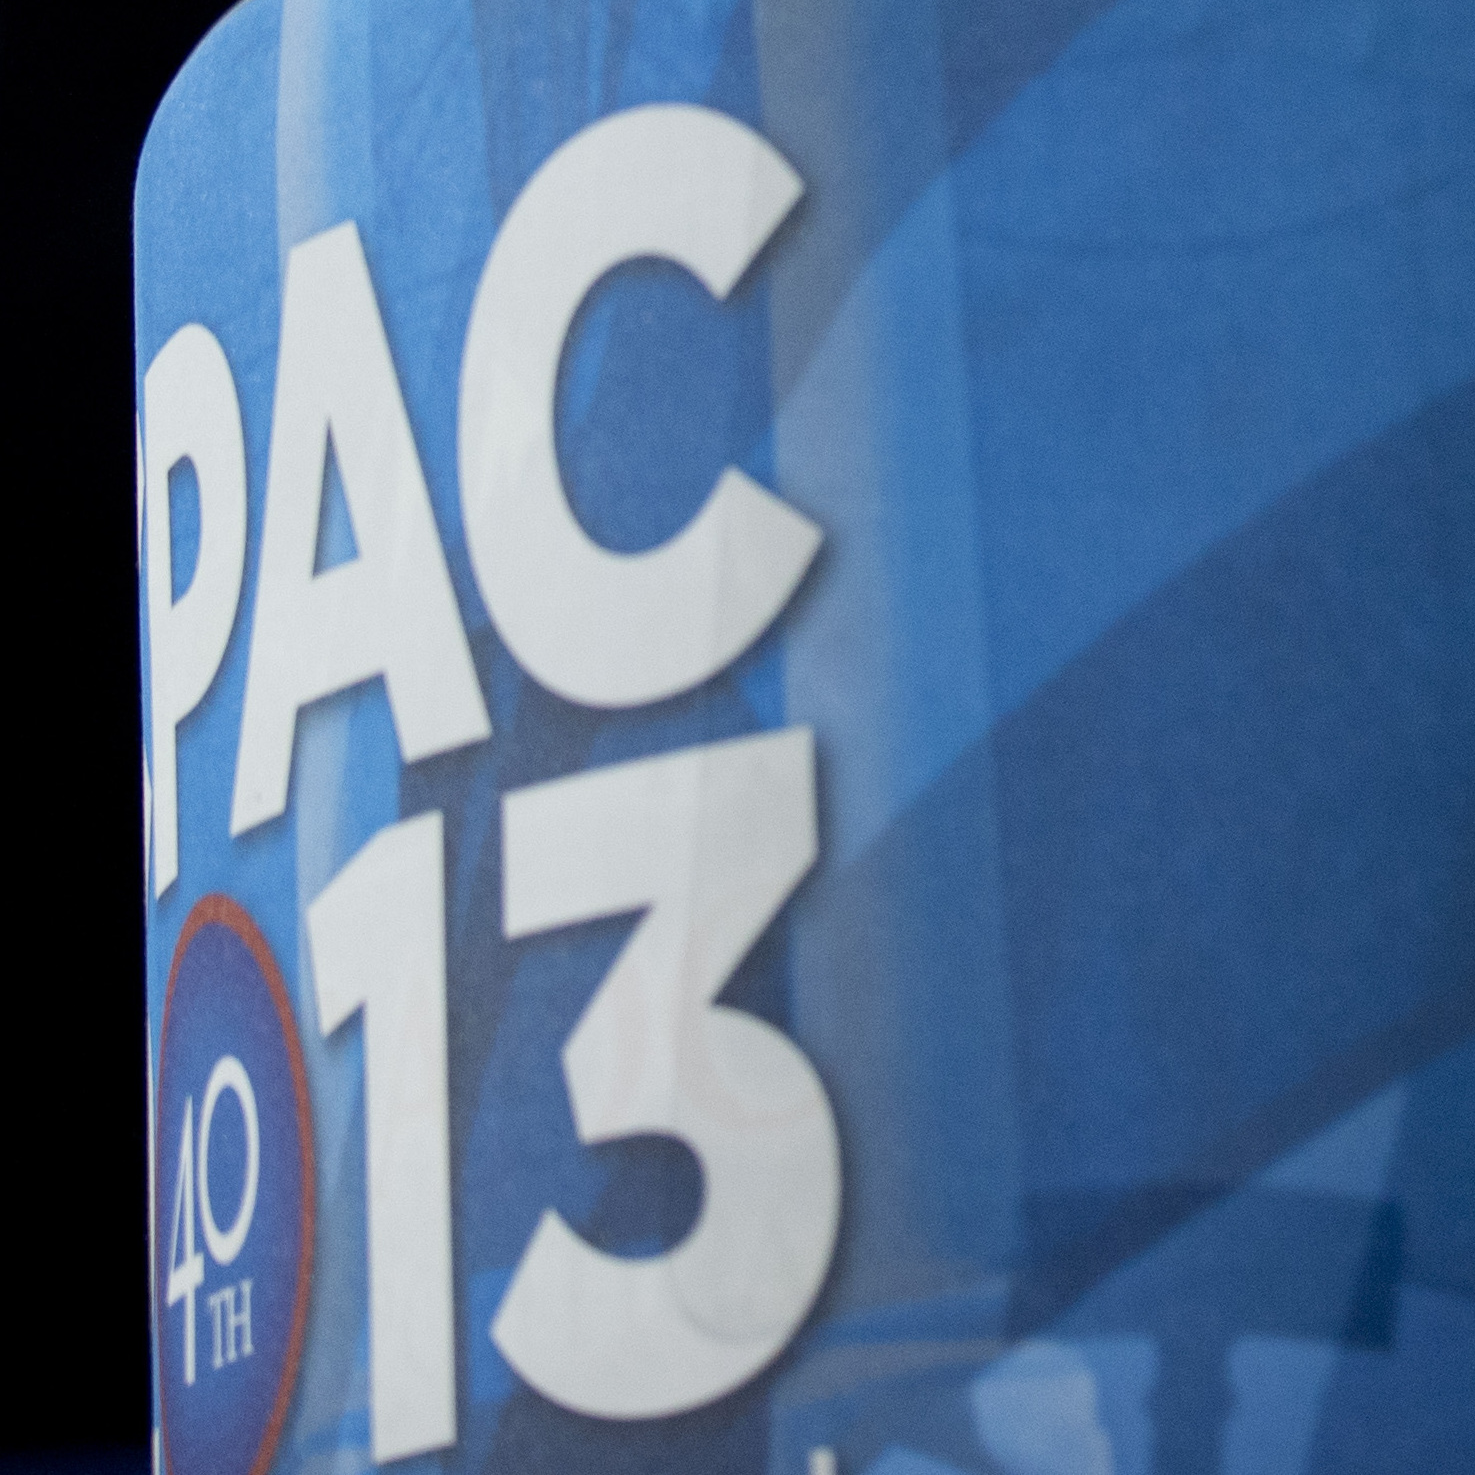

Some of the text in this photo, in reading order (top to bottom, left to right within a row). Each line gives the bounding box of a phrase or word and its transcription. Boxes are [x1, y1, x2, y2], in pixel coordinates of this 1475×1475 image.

[137, 103, 824, 899] PAC
[167, 1055, 260, 1387] 40
[209, 1277, 254, 1369] TH
